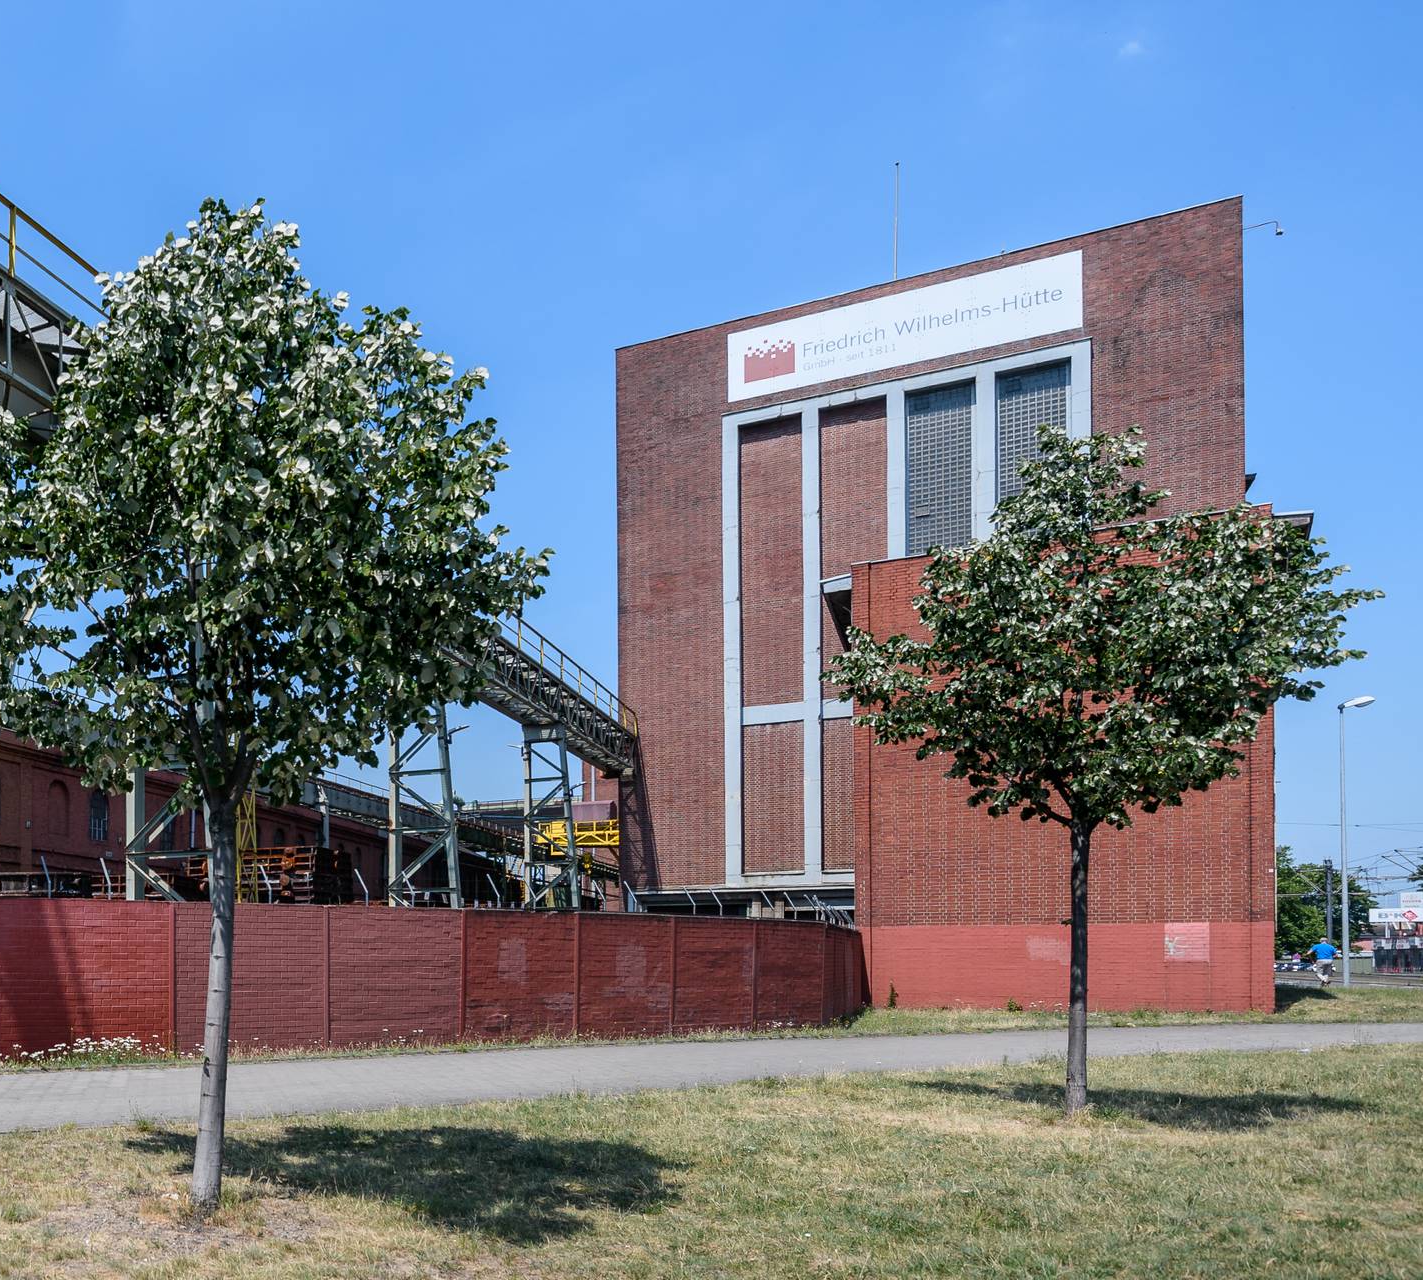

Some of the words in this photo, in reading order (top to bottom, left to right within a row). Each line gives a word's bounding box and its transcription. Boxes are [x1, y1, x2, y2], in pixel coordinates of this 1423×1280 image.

[802, 327, 885, 358] Friedrich
[894, 288, 1063, 336] Wilhelms-Hütte
[802, 357, 835, 372] GmbH
[846, 351, 865, 362] seit
[869, 343, 896, 357] 1811
